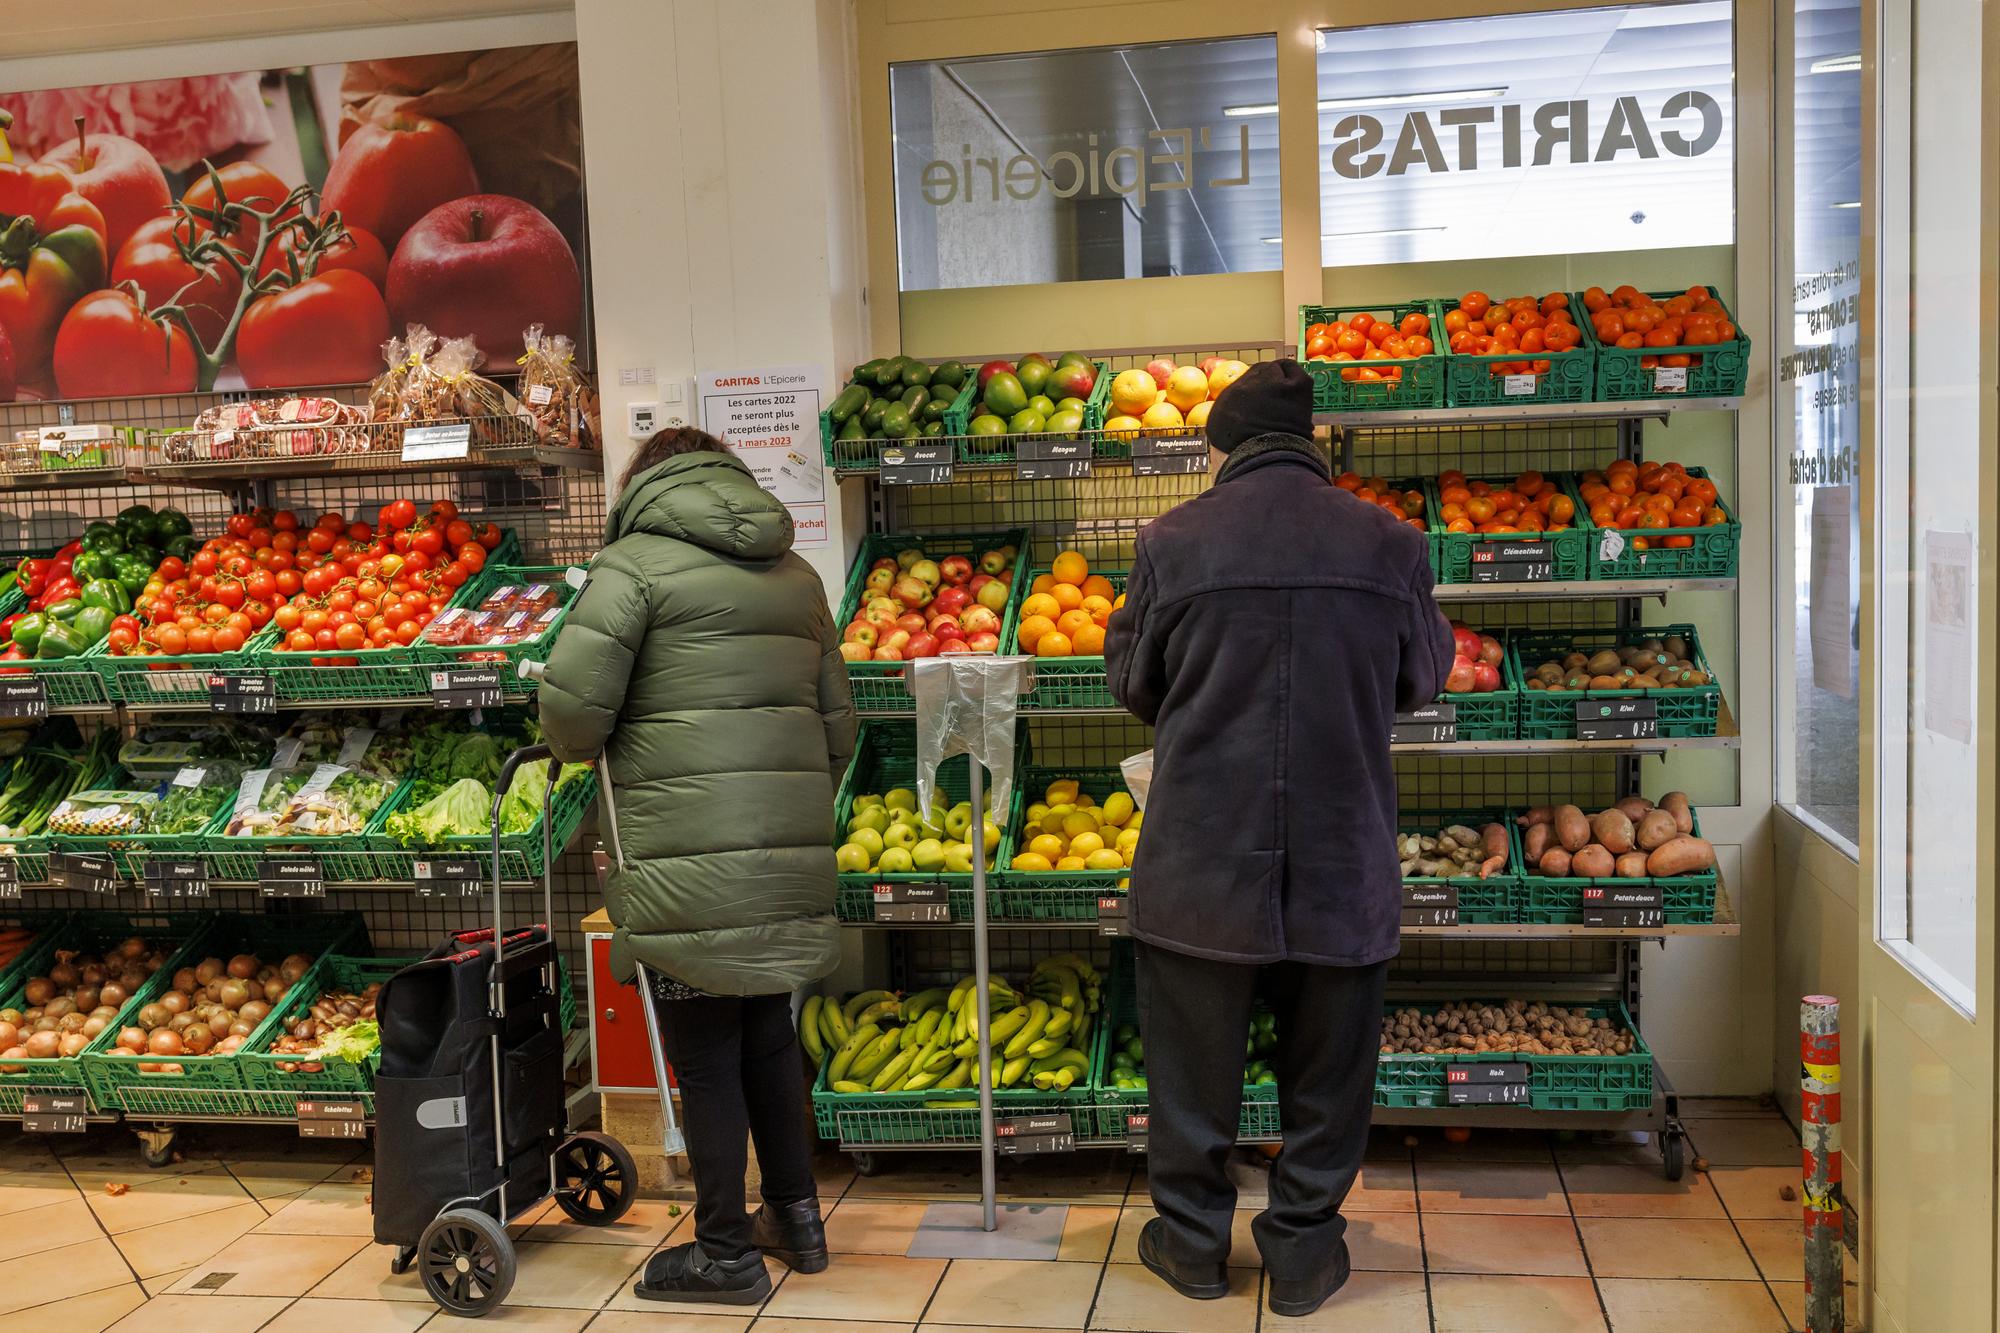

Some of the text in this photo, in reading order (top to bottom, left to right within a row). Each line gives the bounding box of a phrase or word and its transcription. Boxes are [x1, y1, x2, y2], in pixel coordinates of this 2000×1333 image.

[715, 375, 806, 387] CARITAS L'Epicerie
[728, 395, 796, 408] Les cartes 2022
[731, 409, 795, 421] ne seront plus
[727, 421, 800, 435] acceptées dès le
[737, 436, 792, 448] 1 mars 2023
[1156, 440, 1203, 449] Pamplemousse
[1052, 446, 1077, 455] Mangue
[1477, 553, 1492, 561] 105
[1413, 709, 1439, 717] Grenade
[877, 885, 891, 893] 122
[1587, 889, 1604, 897] 117
[1413, 893, 1447, 902] Gingembre
[1614, 894, 1655, 902] Patate douce
[1102, 899, 1117, 908] 104
[1451, 1072, 1466, 1080] 113
[1000, 1127, 1014, 1135] 102
